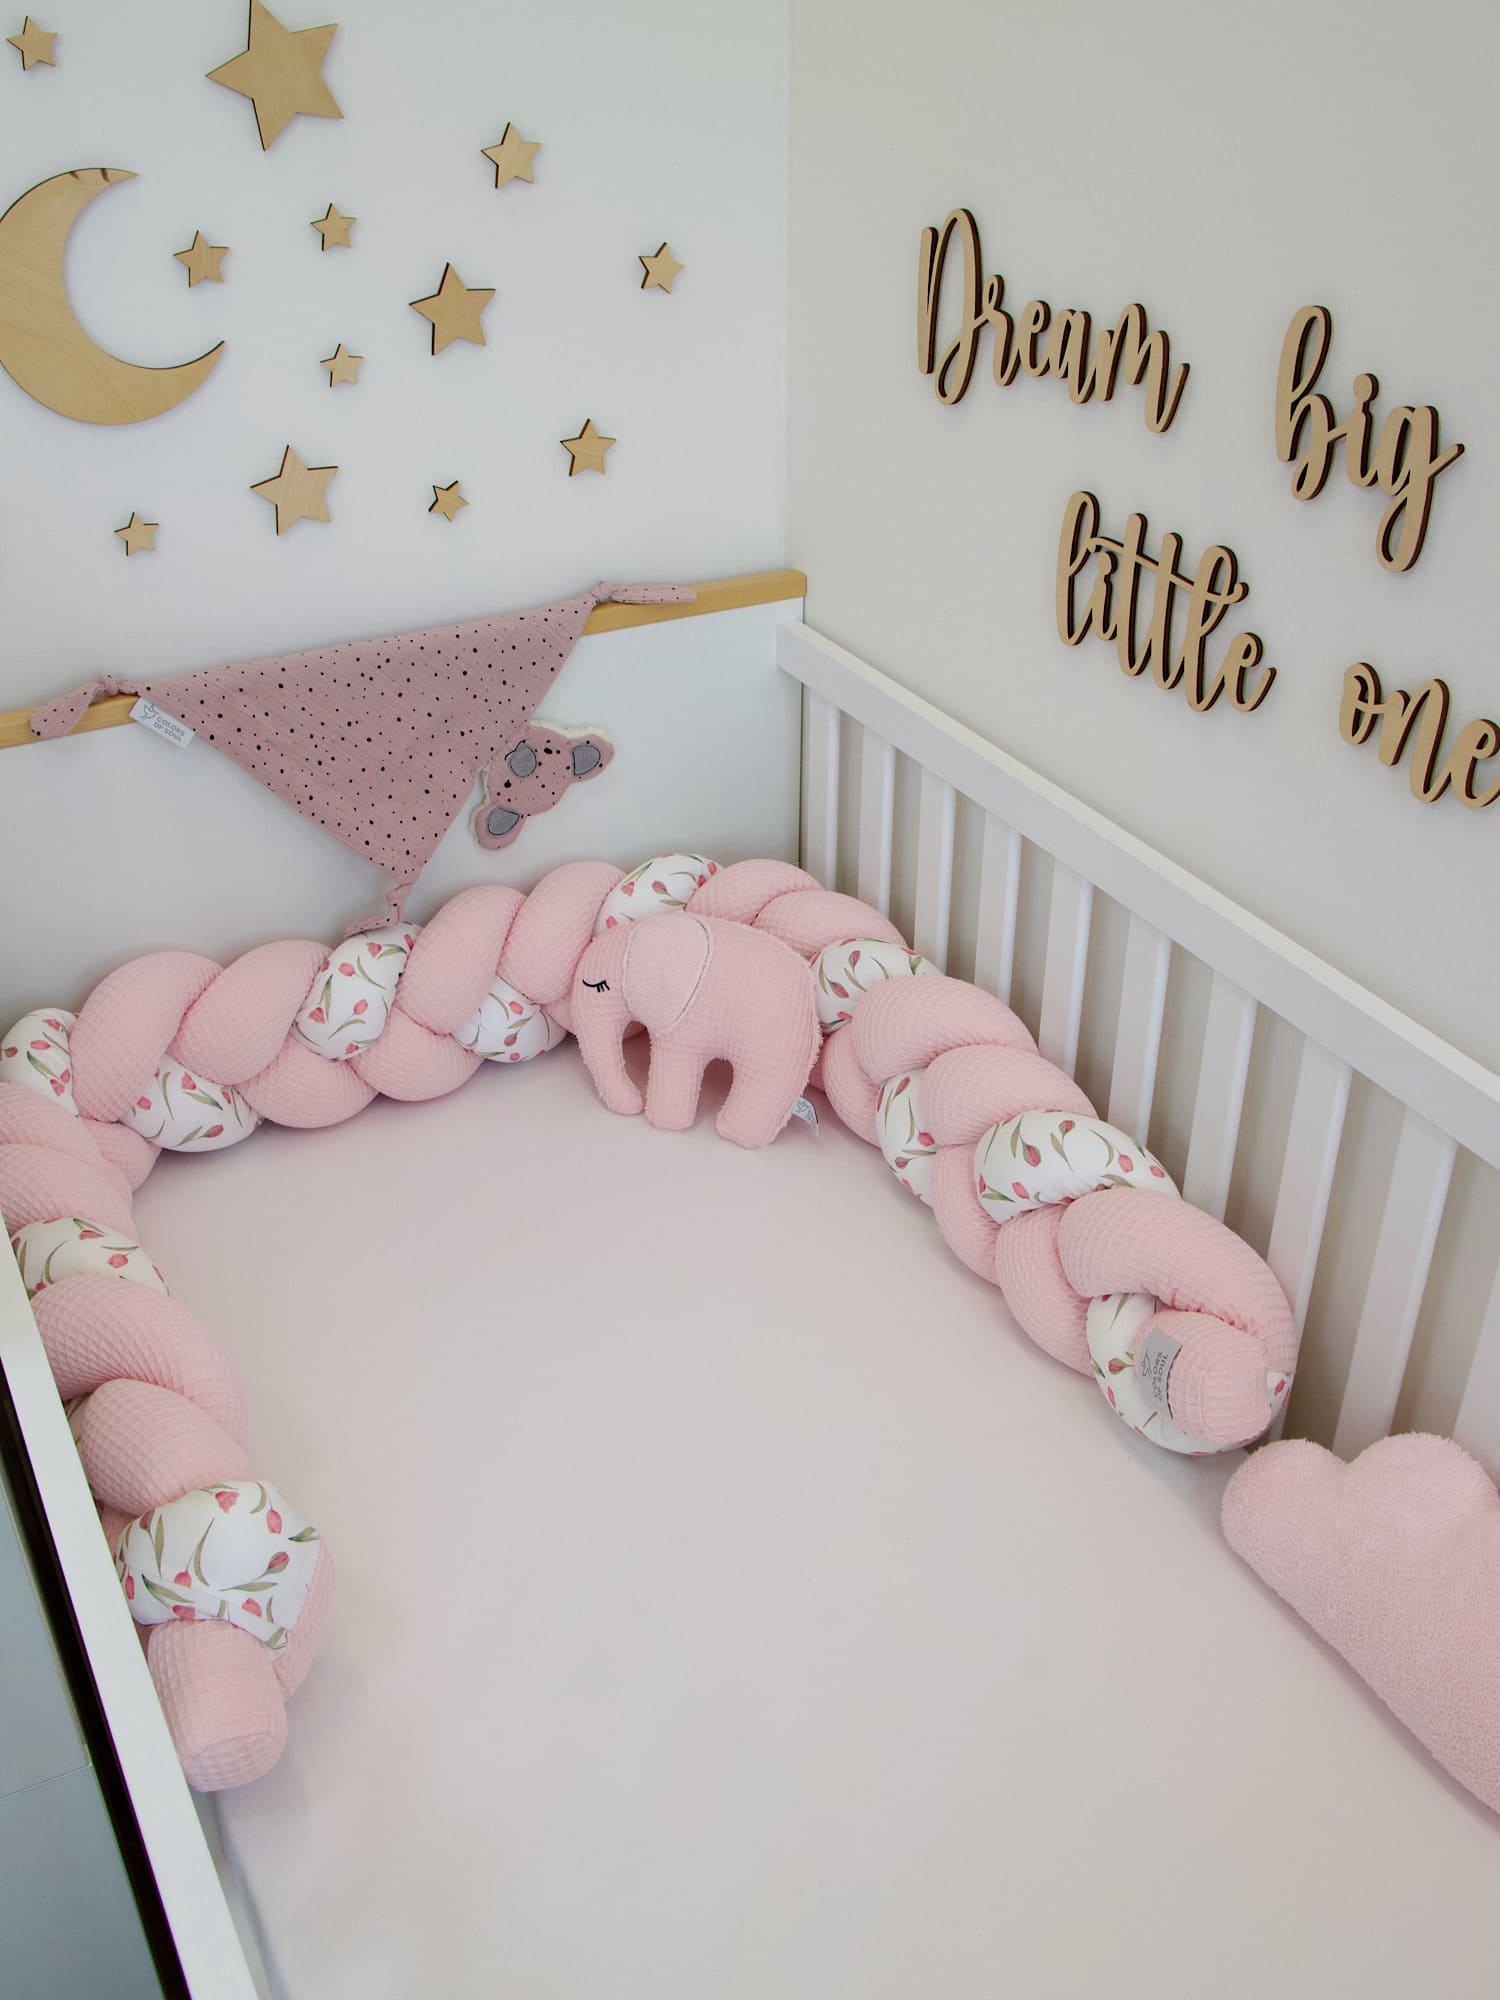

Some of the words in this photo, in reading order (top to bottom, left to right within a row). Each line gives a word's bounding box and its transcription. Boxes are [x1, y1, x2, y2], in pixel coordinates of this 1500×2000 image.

[917, 208, 1190, 434] Dream
[1275, 304, 1465, 573] big
[156, 716, 185, 737] COLORS
[1055, 490, 1277, 713] little
[1339, 662, 1500, 809] one
